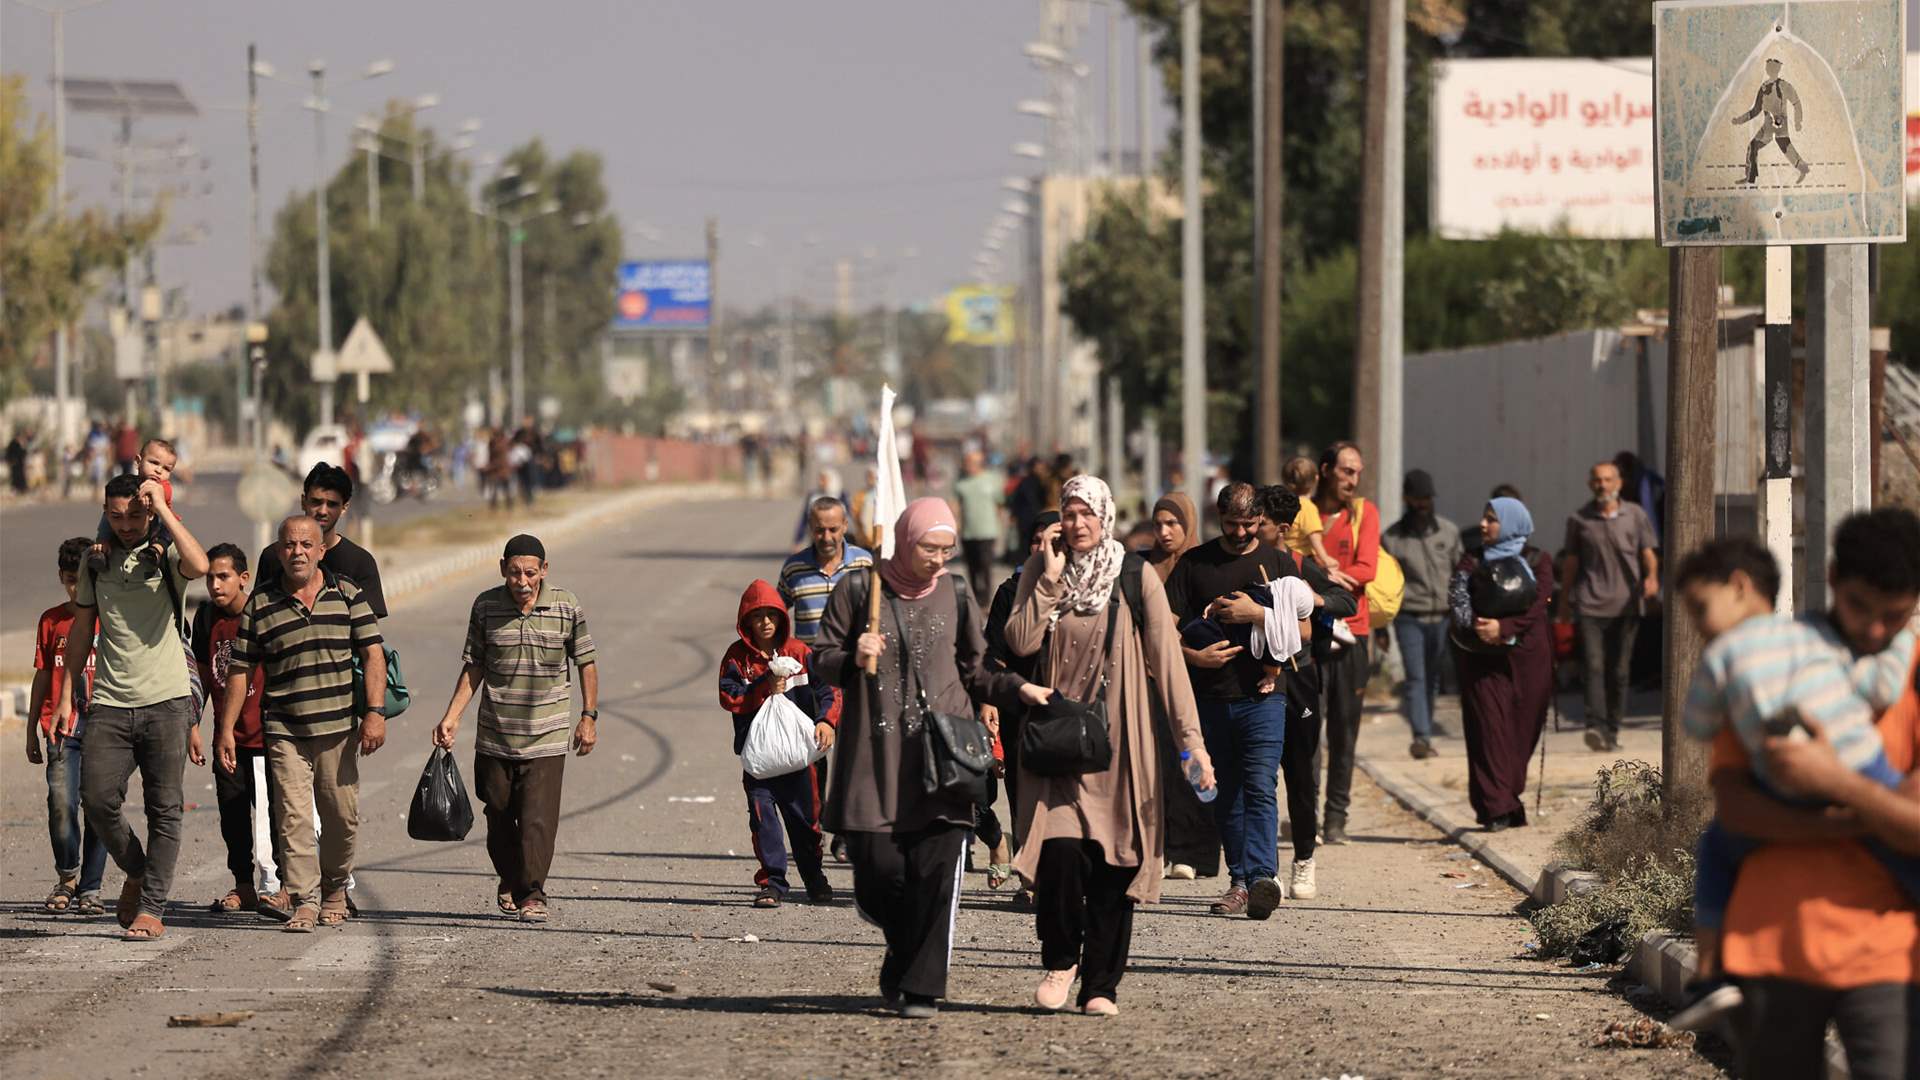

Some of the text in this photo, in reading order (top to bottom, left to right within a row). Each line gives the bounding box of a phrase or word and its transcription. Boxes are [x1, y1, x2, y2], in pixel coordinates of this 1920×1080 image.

[1463, 90, 1568, 127] الوادية
[1549, 156, 1560, 173] و
[1568, 149, 1642, 173] الوادية
